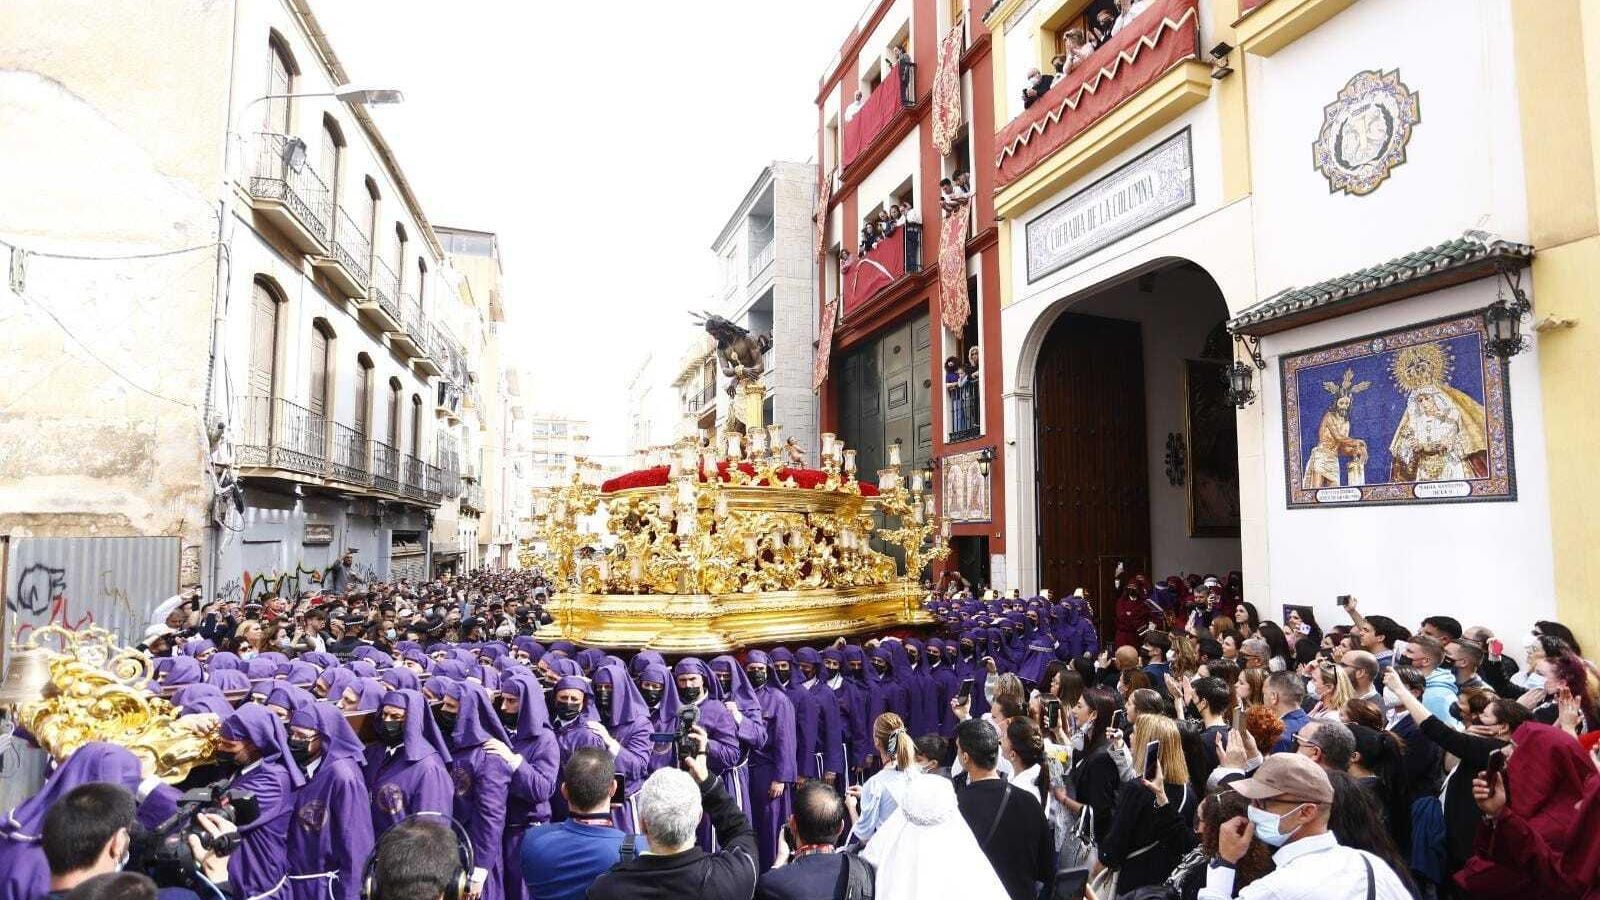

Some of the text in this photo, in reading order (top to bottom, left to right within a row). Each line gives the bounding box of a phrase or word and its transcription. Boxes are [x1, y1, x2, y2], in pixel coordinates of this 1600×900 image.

[1088, 207, 1096, 231] DE
[1100, 199, 1111, 225] LA
[1113, 175, 1154, 218] COLUMNA
